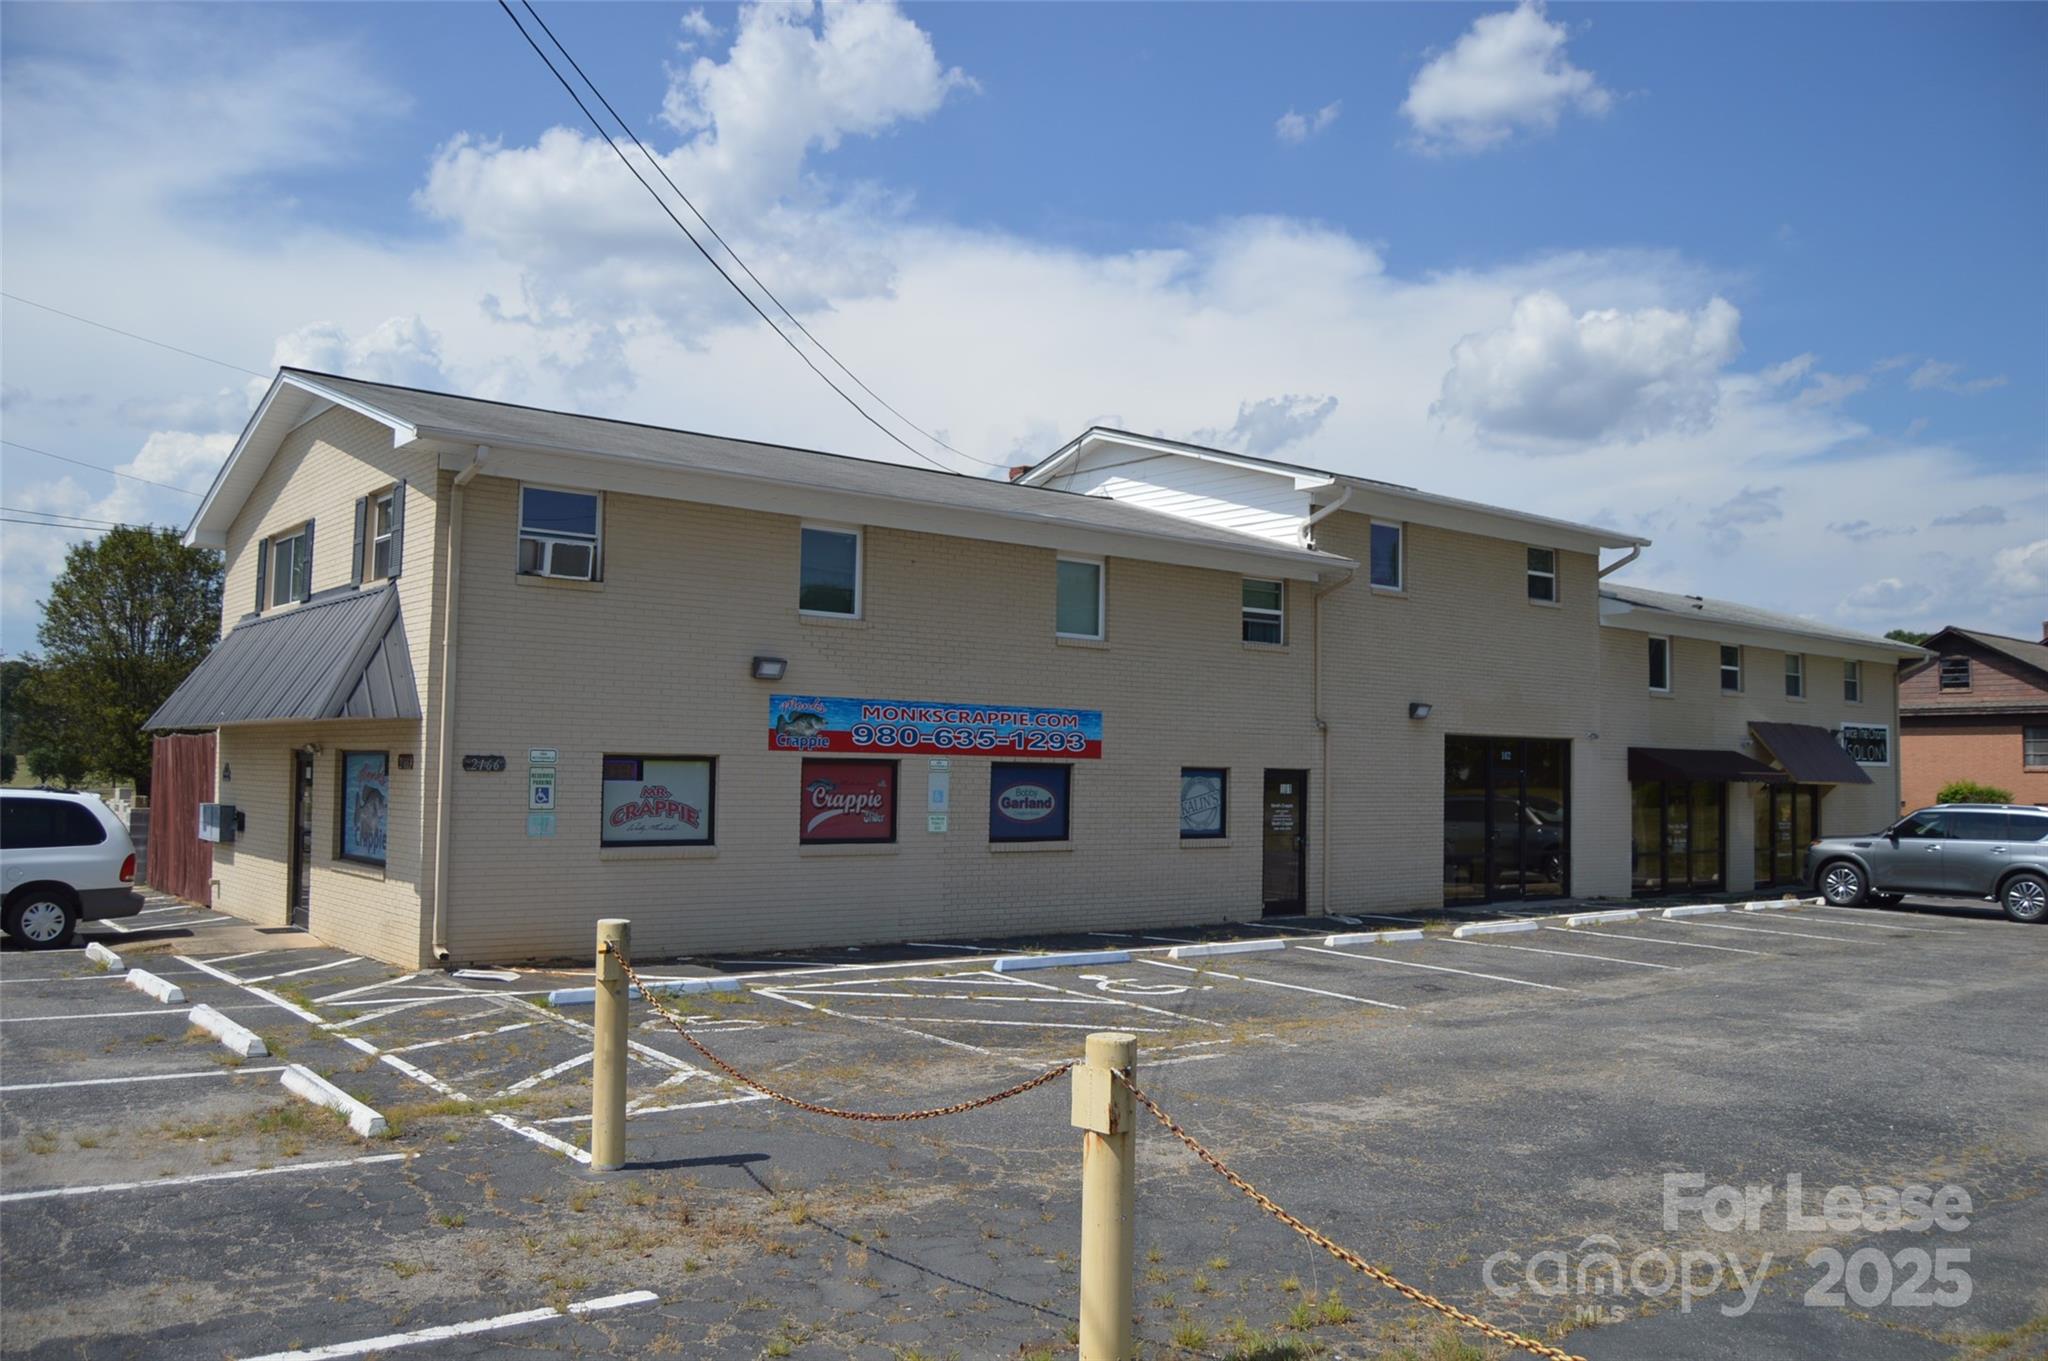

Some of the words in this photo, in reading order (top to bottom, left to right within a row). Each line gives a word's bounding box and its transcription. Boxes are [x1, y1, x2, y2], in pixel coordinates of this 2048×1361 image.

[861, 705, 1079, 729] MONKSCRAPPIE.COM
[776, 733, 830, 750] Crappie
[851, 723, 1087, 752] 980-635-1293
[471, 758, 500, 770] 2166
[812, 784, 883, 813] Crappie
[1001, 797, 1052, 809] Garland
[609, 799, 700, 830] CRAPPIE
